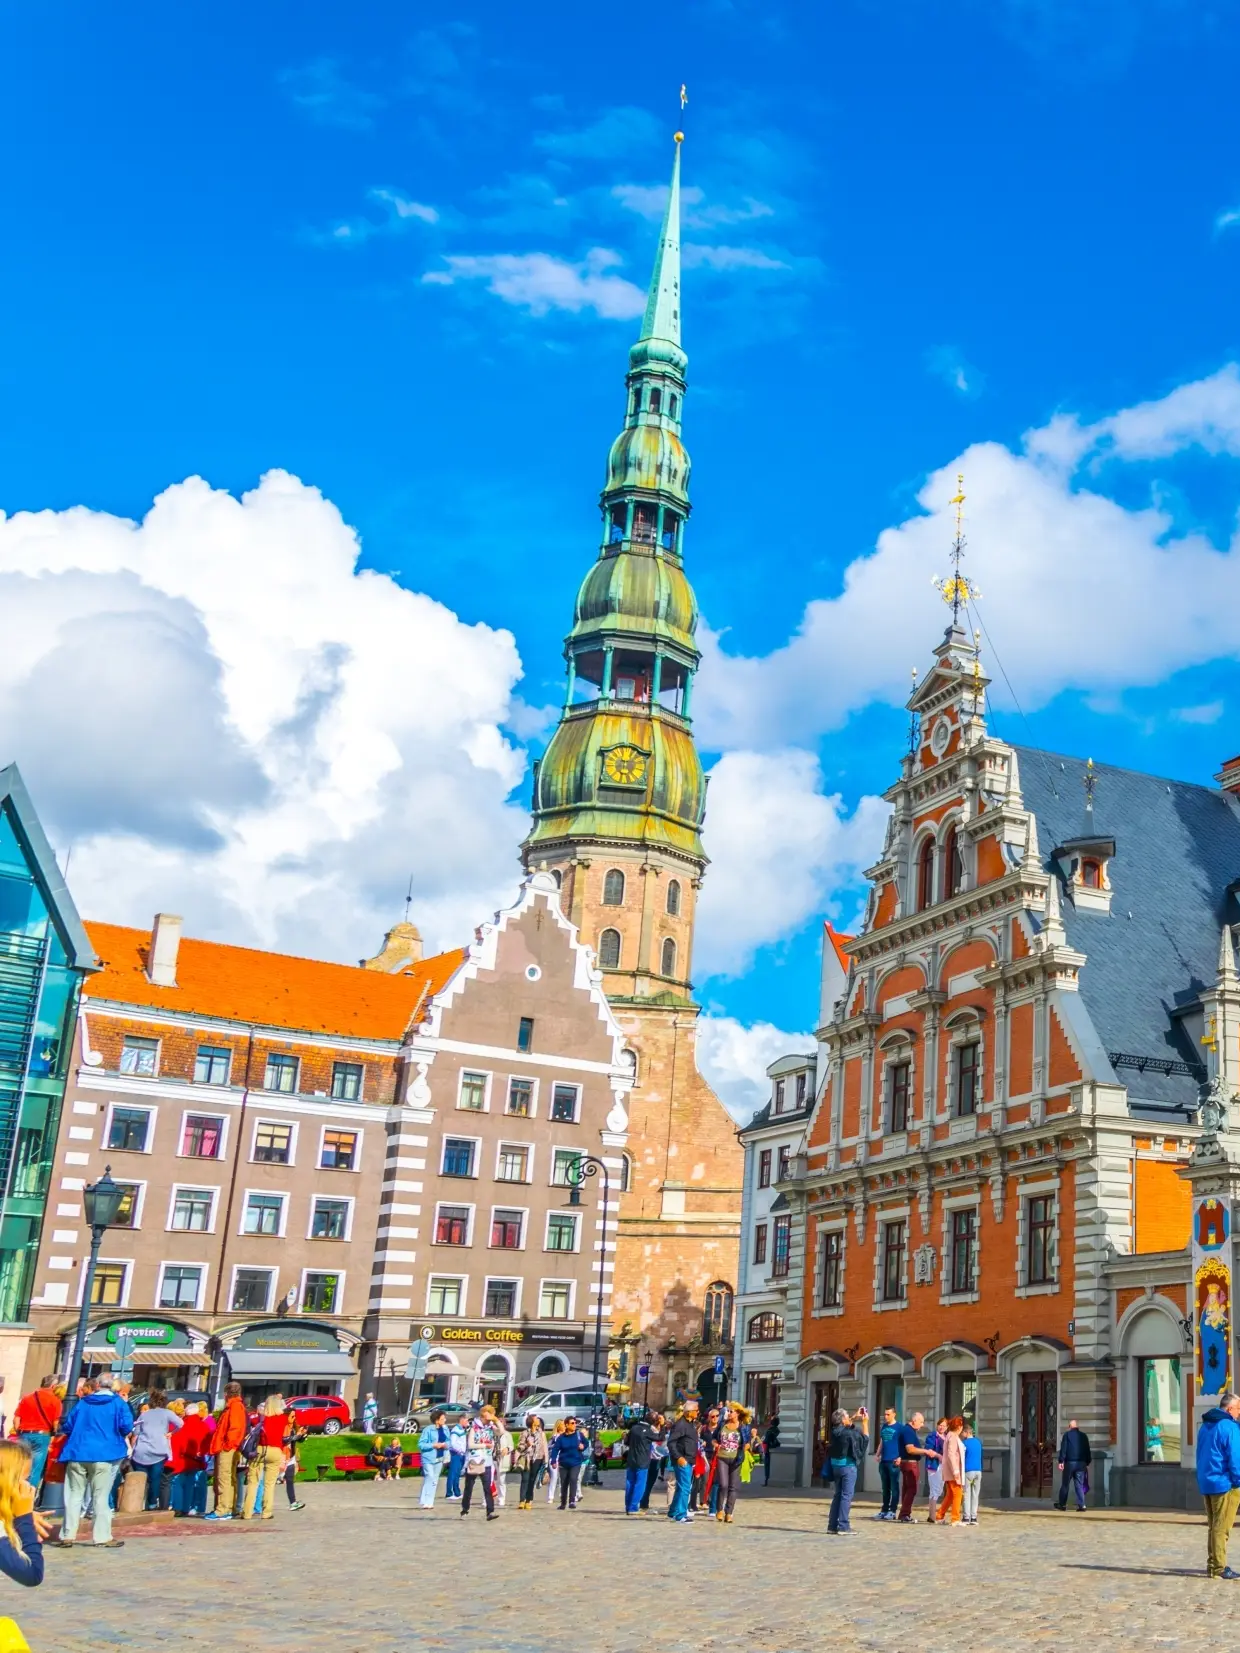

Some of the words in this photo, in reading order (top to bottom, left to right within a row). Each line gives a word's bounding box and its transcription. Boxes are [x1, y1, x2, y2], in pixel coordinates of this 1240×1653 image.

[118, 1326, 165, 1337] Province
[442, 1327, 482, 1340] Golden
[485, 1328, 524, 1342] Coffee
